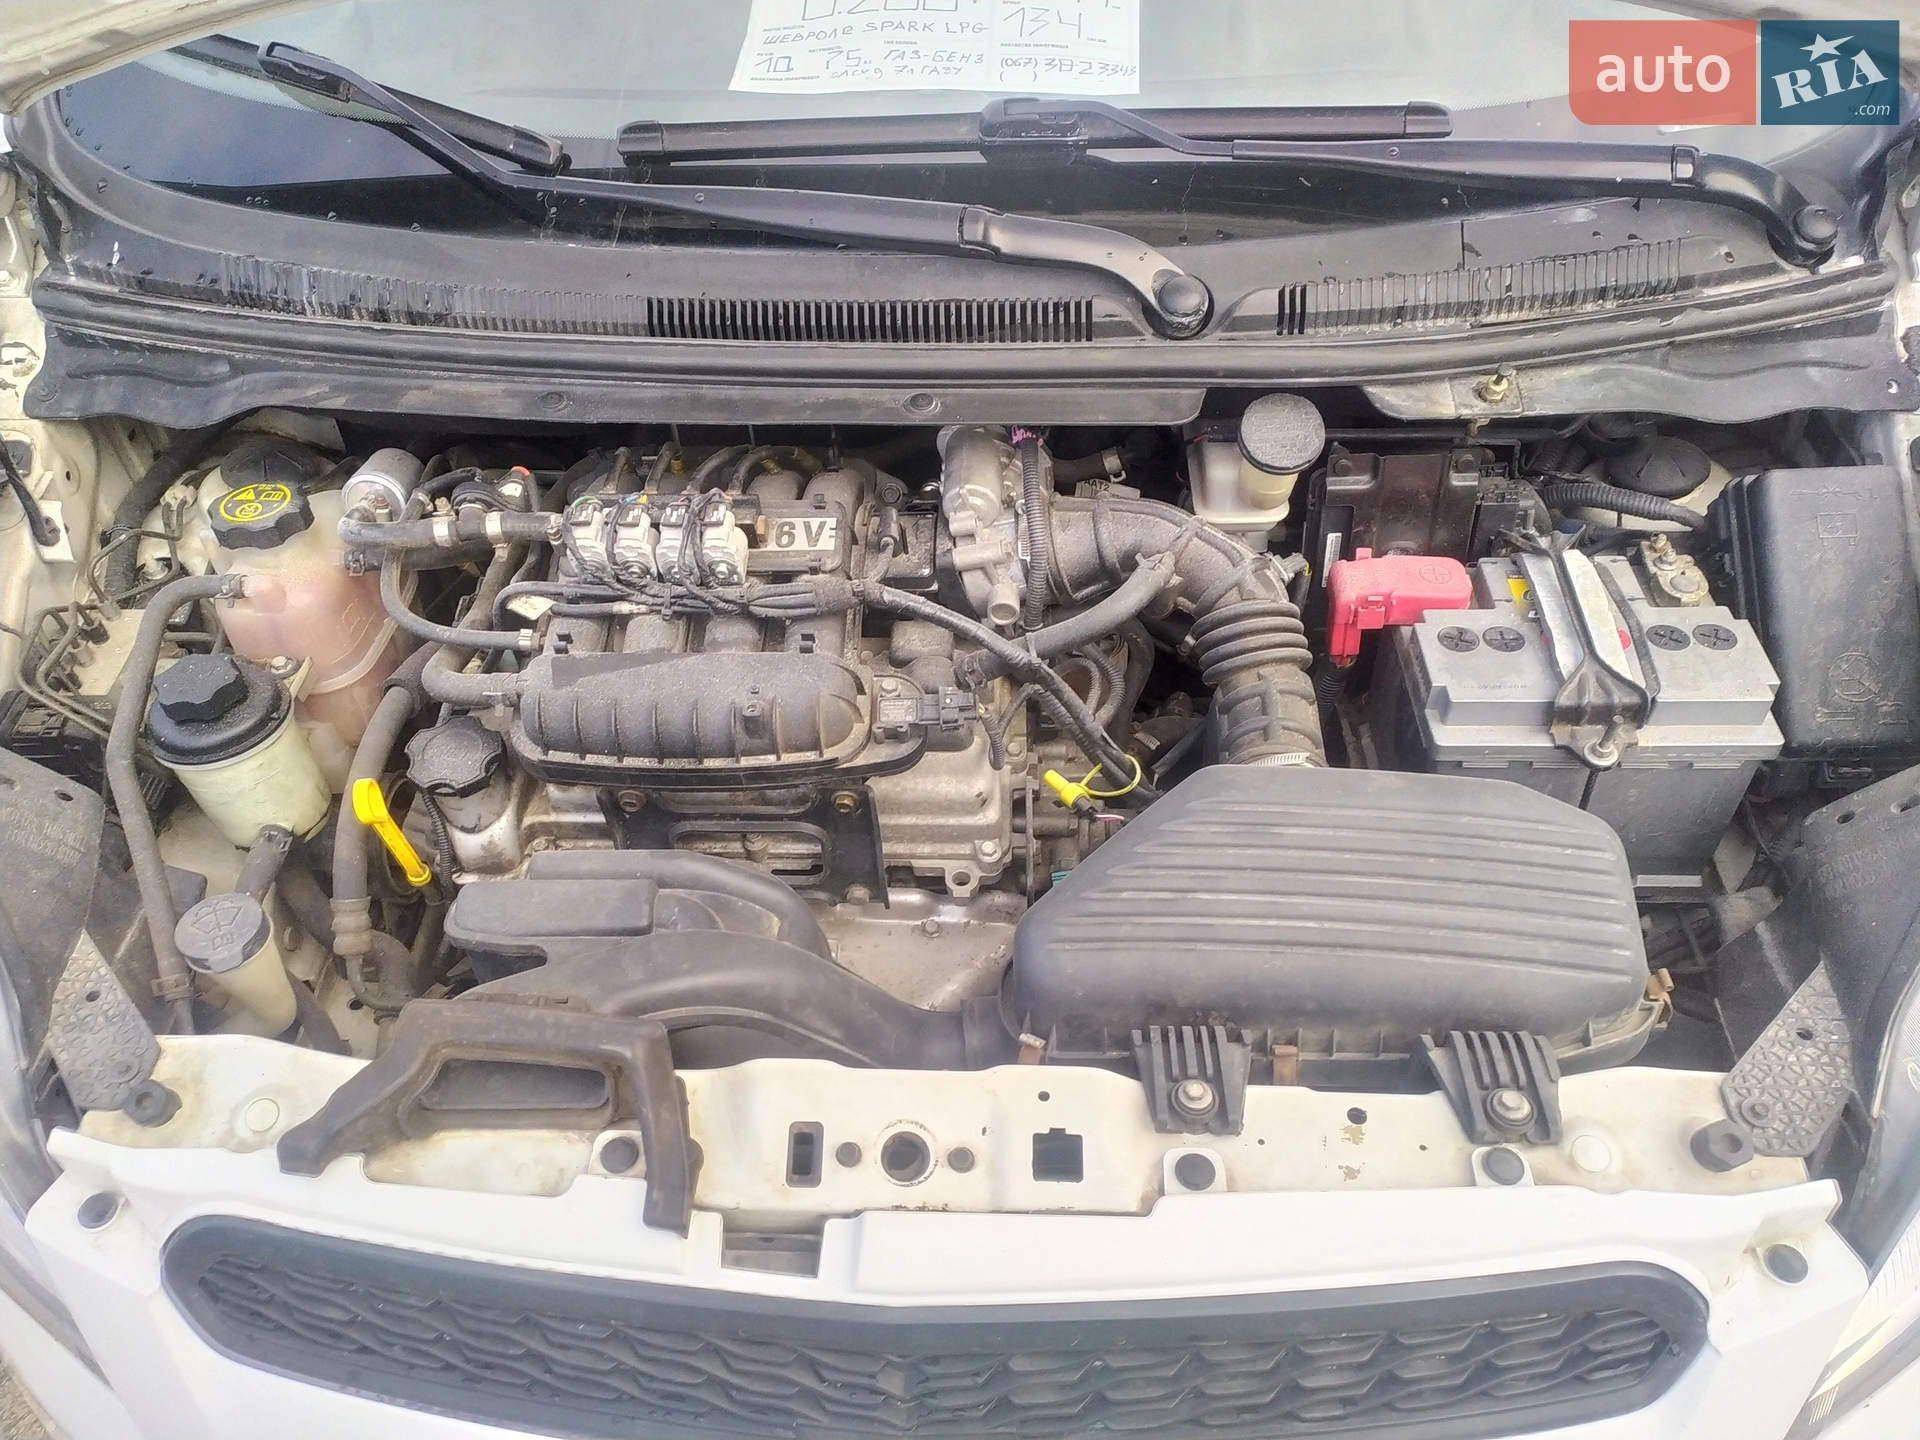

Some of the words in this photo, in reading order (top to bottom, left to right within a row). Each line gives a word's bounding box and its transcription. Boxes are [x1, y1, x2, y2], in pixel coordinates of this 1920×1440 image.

[862, 20, 935, 33] SPARK
[945, 21, 989, 34] LPG
[1003, 7, 1082, 38] 134
[1000, 57, 1038, 69] (067)
